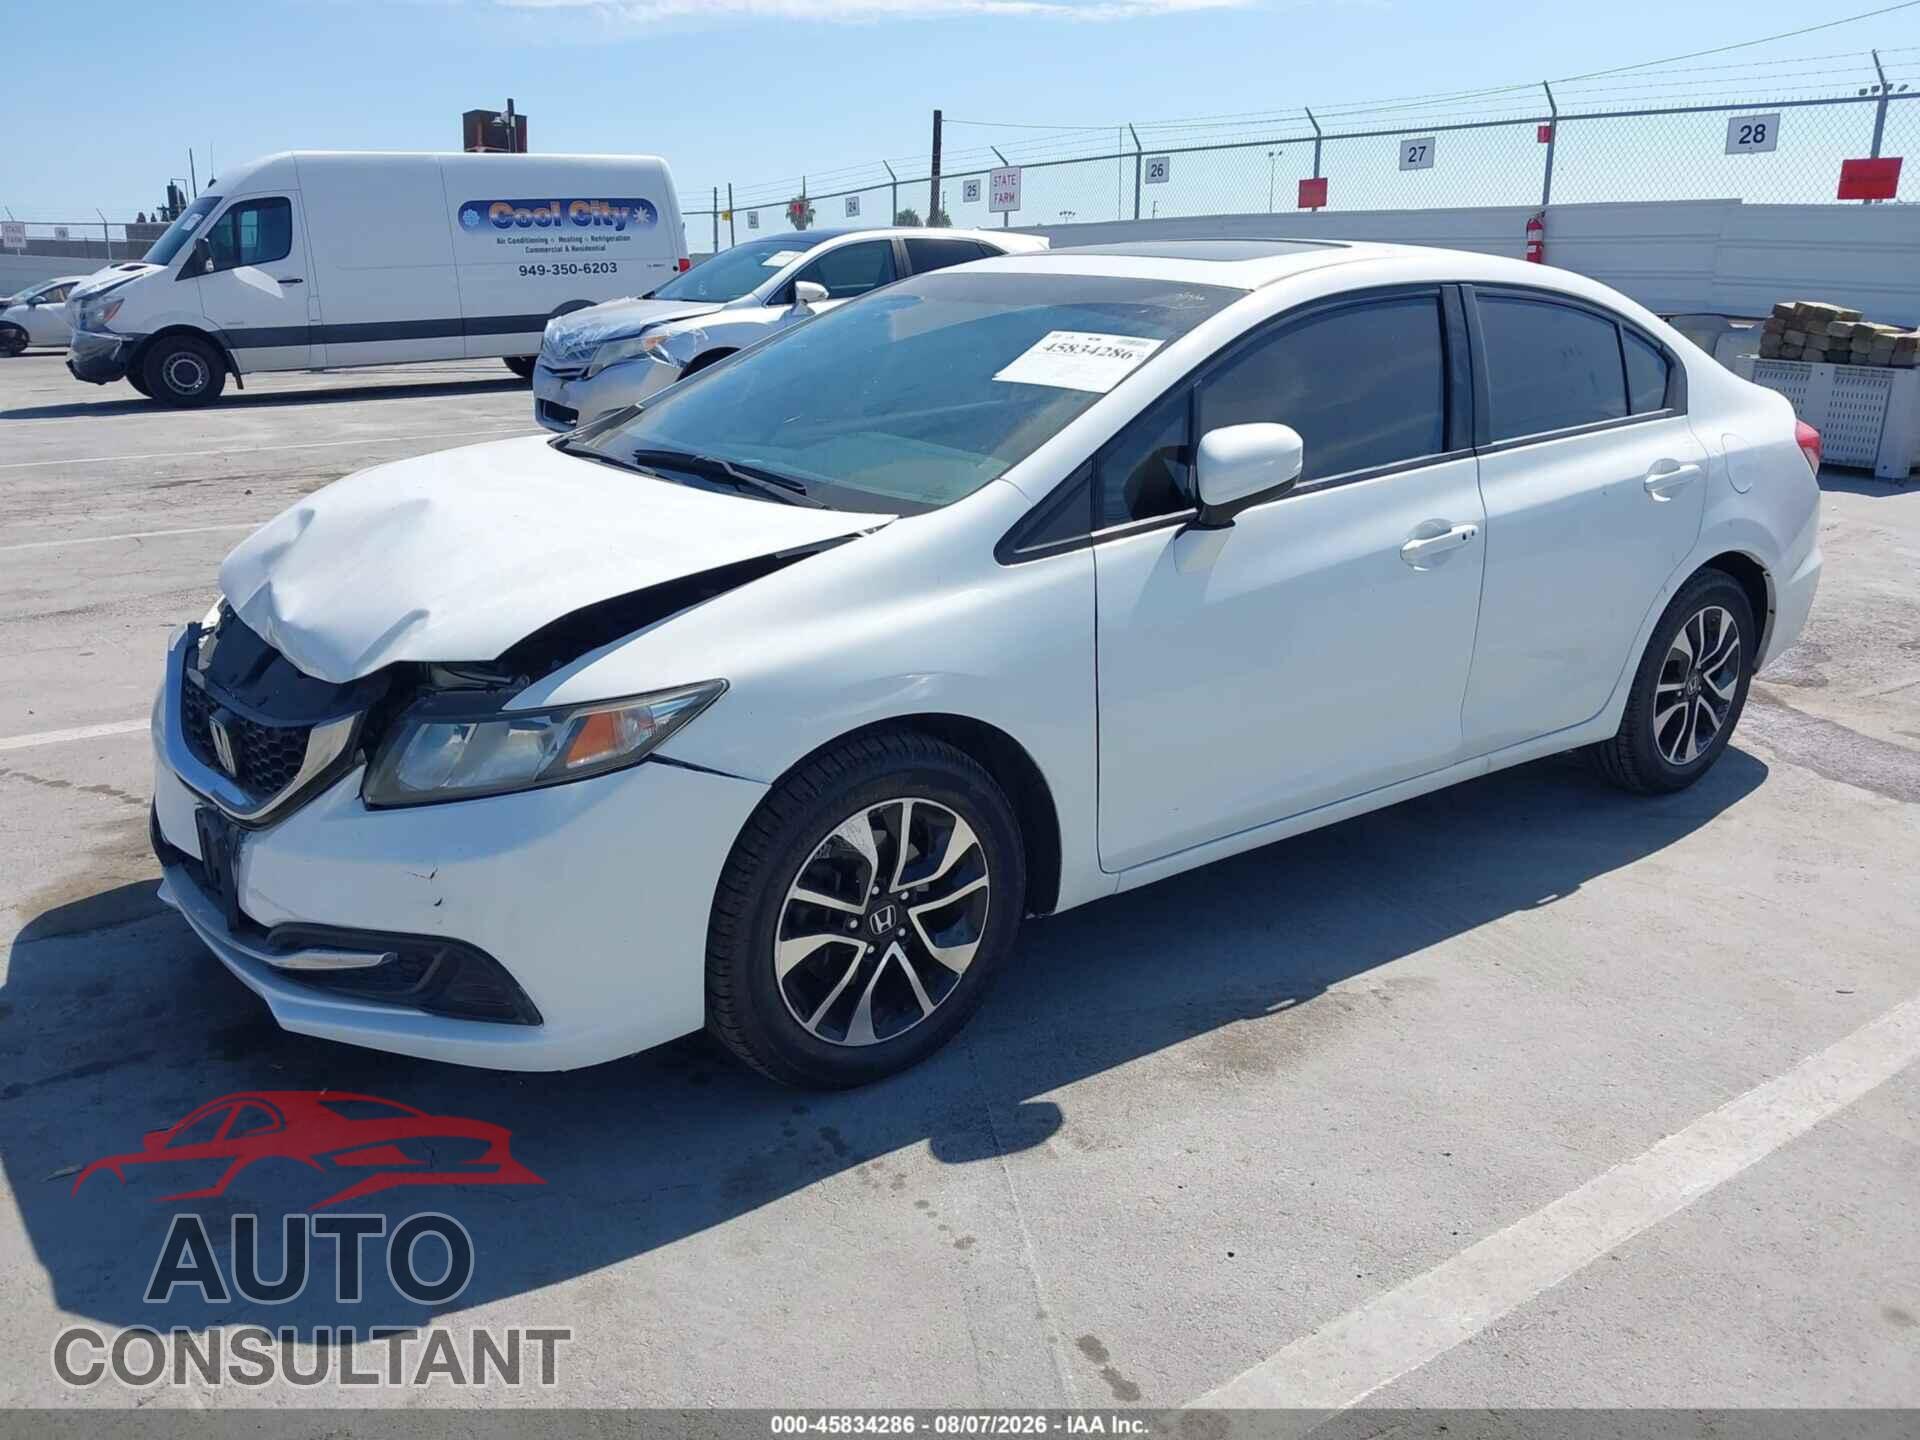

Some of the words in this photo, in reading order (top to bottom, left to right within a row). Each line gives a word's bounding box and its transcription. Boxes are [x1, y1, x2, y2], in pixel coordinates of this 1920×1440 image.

[1738, 124, 1767, 144] 28
[1407, 145, 1427, 162] 27
[1151, 163, 1164, 178] 26
[993, 173, 1017, 187] STATE
[967, 184, 977, 198] 25
[993, 191, 1016, 204] FARM
[488, 201, 562, 229] Cool
[568, 200, 631, 231] City
[508, 236, 549, 245] Conditioning
[558, 235, 583, 244] Heating
[590, 234, 631, 243] Refrigeration
[525, 245, 563, 253] Commercial
[571, 244, 606, 252] Residential
[518, 261, 618, 277] 949-350-6203
[1043, 341, 1133, 360] 45834286
